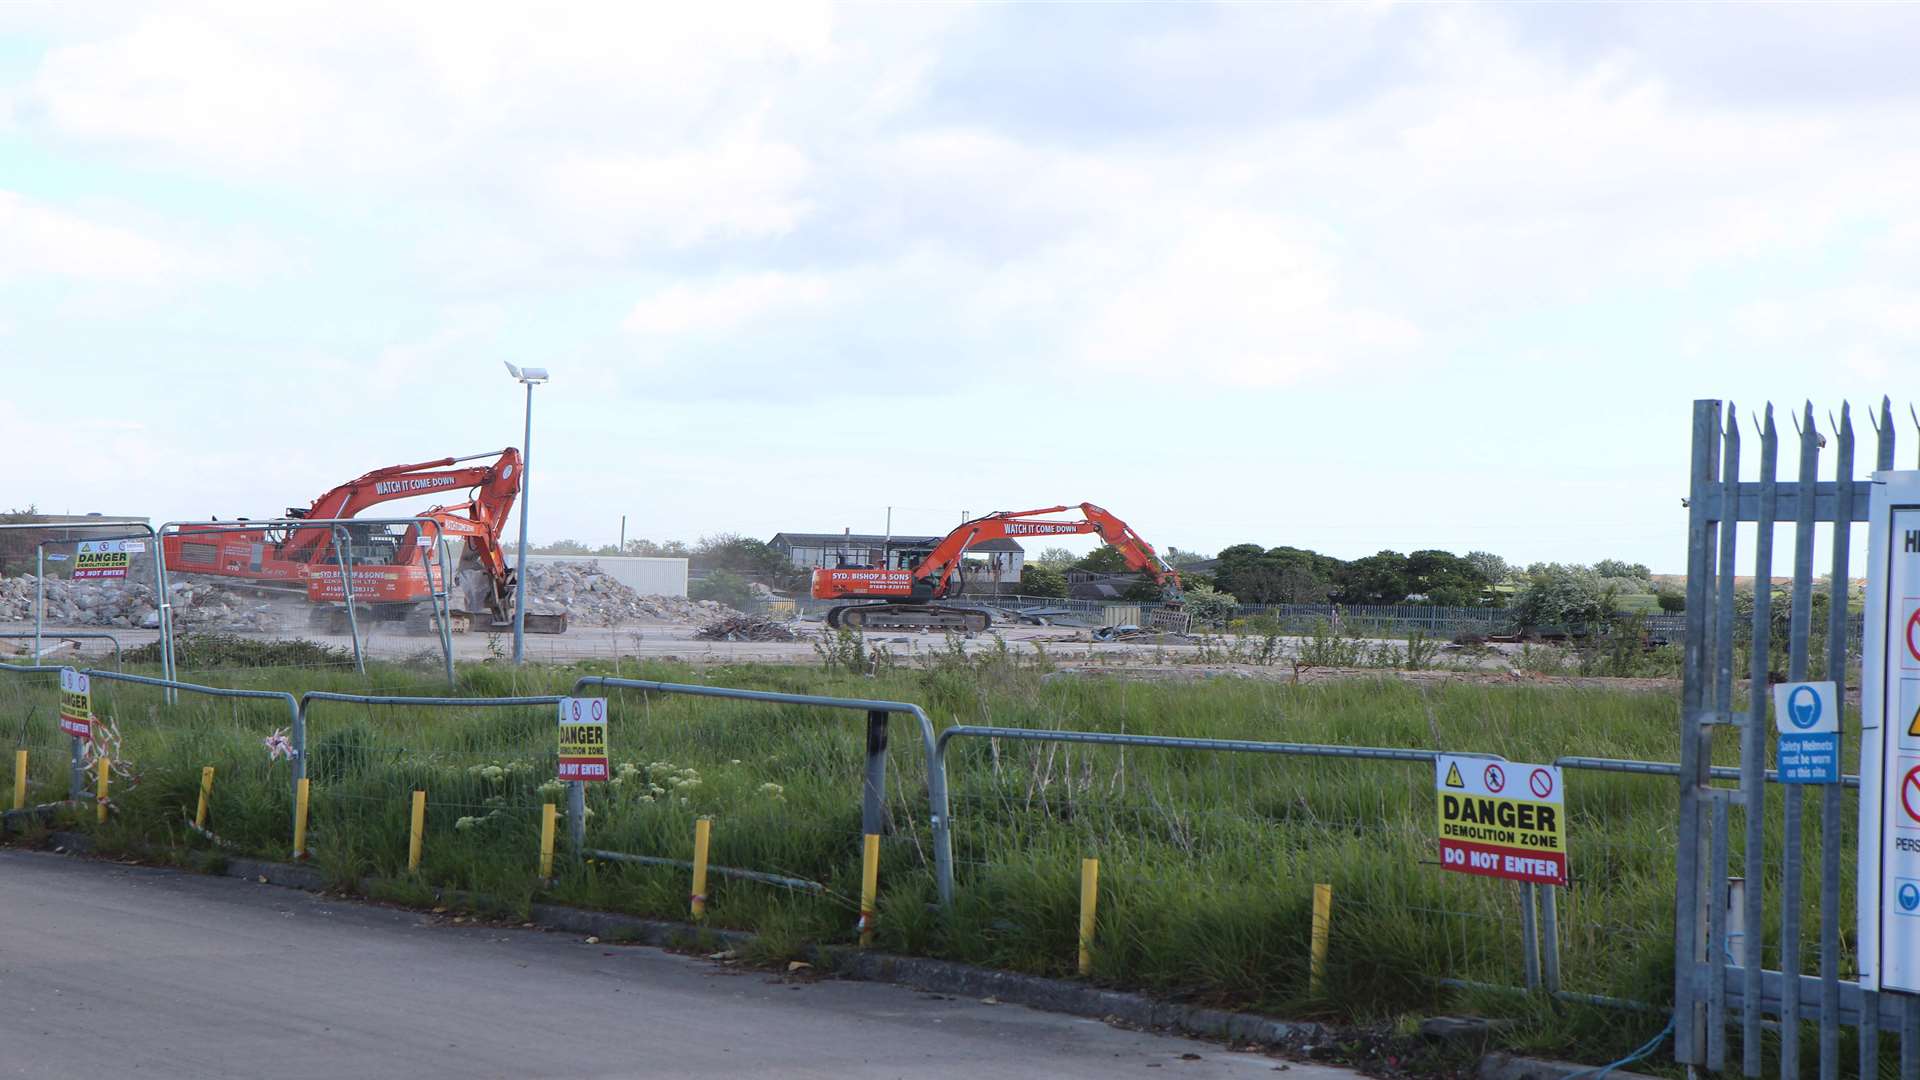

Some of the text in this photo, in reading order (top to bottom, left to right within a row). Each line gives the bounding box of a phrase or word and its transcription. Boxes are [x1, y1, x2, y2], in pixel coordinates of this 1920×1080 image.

[375, 477, 456, 495] WATCH IT COME DOWN
[1004, 523, 1077, 534] WATCH IT COME DOWN
[79, 552, 127, 563] DANGER
[560, 726, 603, 744] DANGER
[1780, 740, 1833, 753] Safety Helmets
[1782, 754, 1831, 765] must be worn
[581, 763, 605, 776] ENTER
[1786, 767, 1827, 778] on this site
[1443, 795, 1556, 832] DANGER
[1444, 823, 1558, 849] DEMOLITION ZONE
[1444, 847, 1559, 877] DO NOT ENTER
